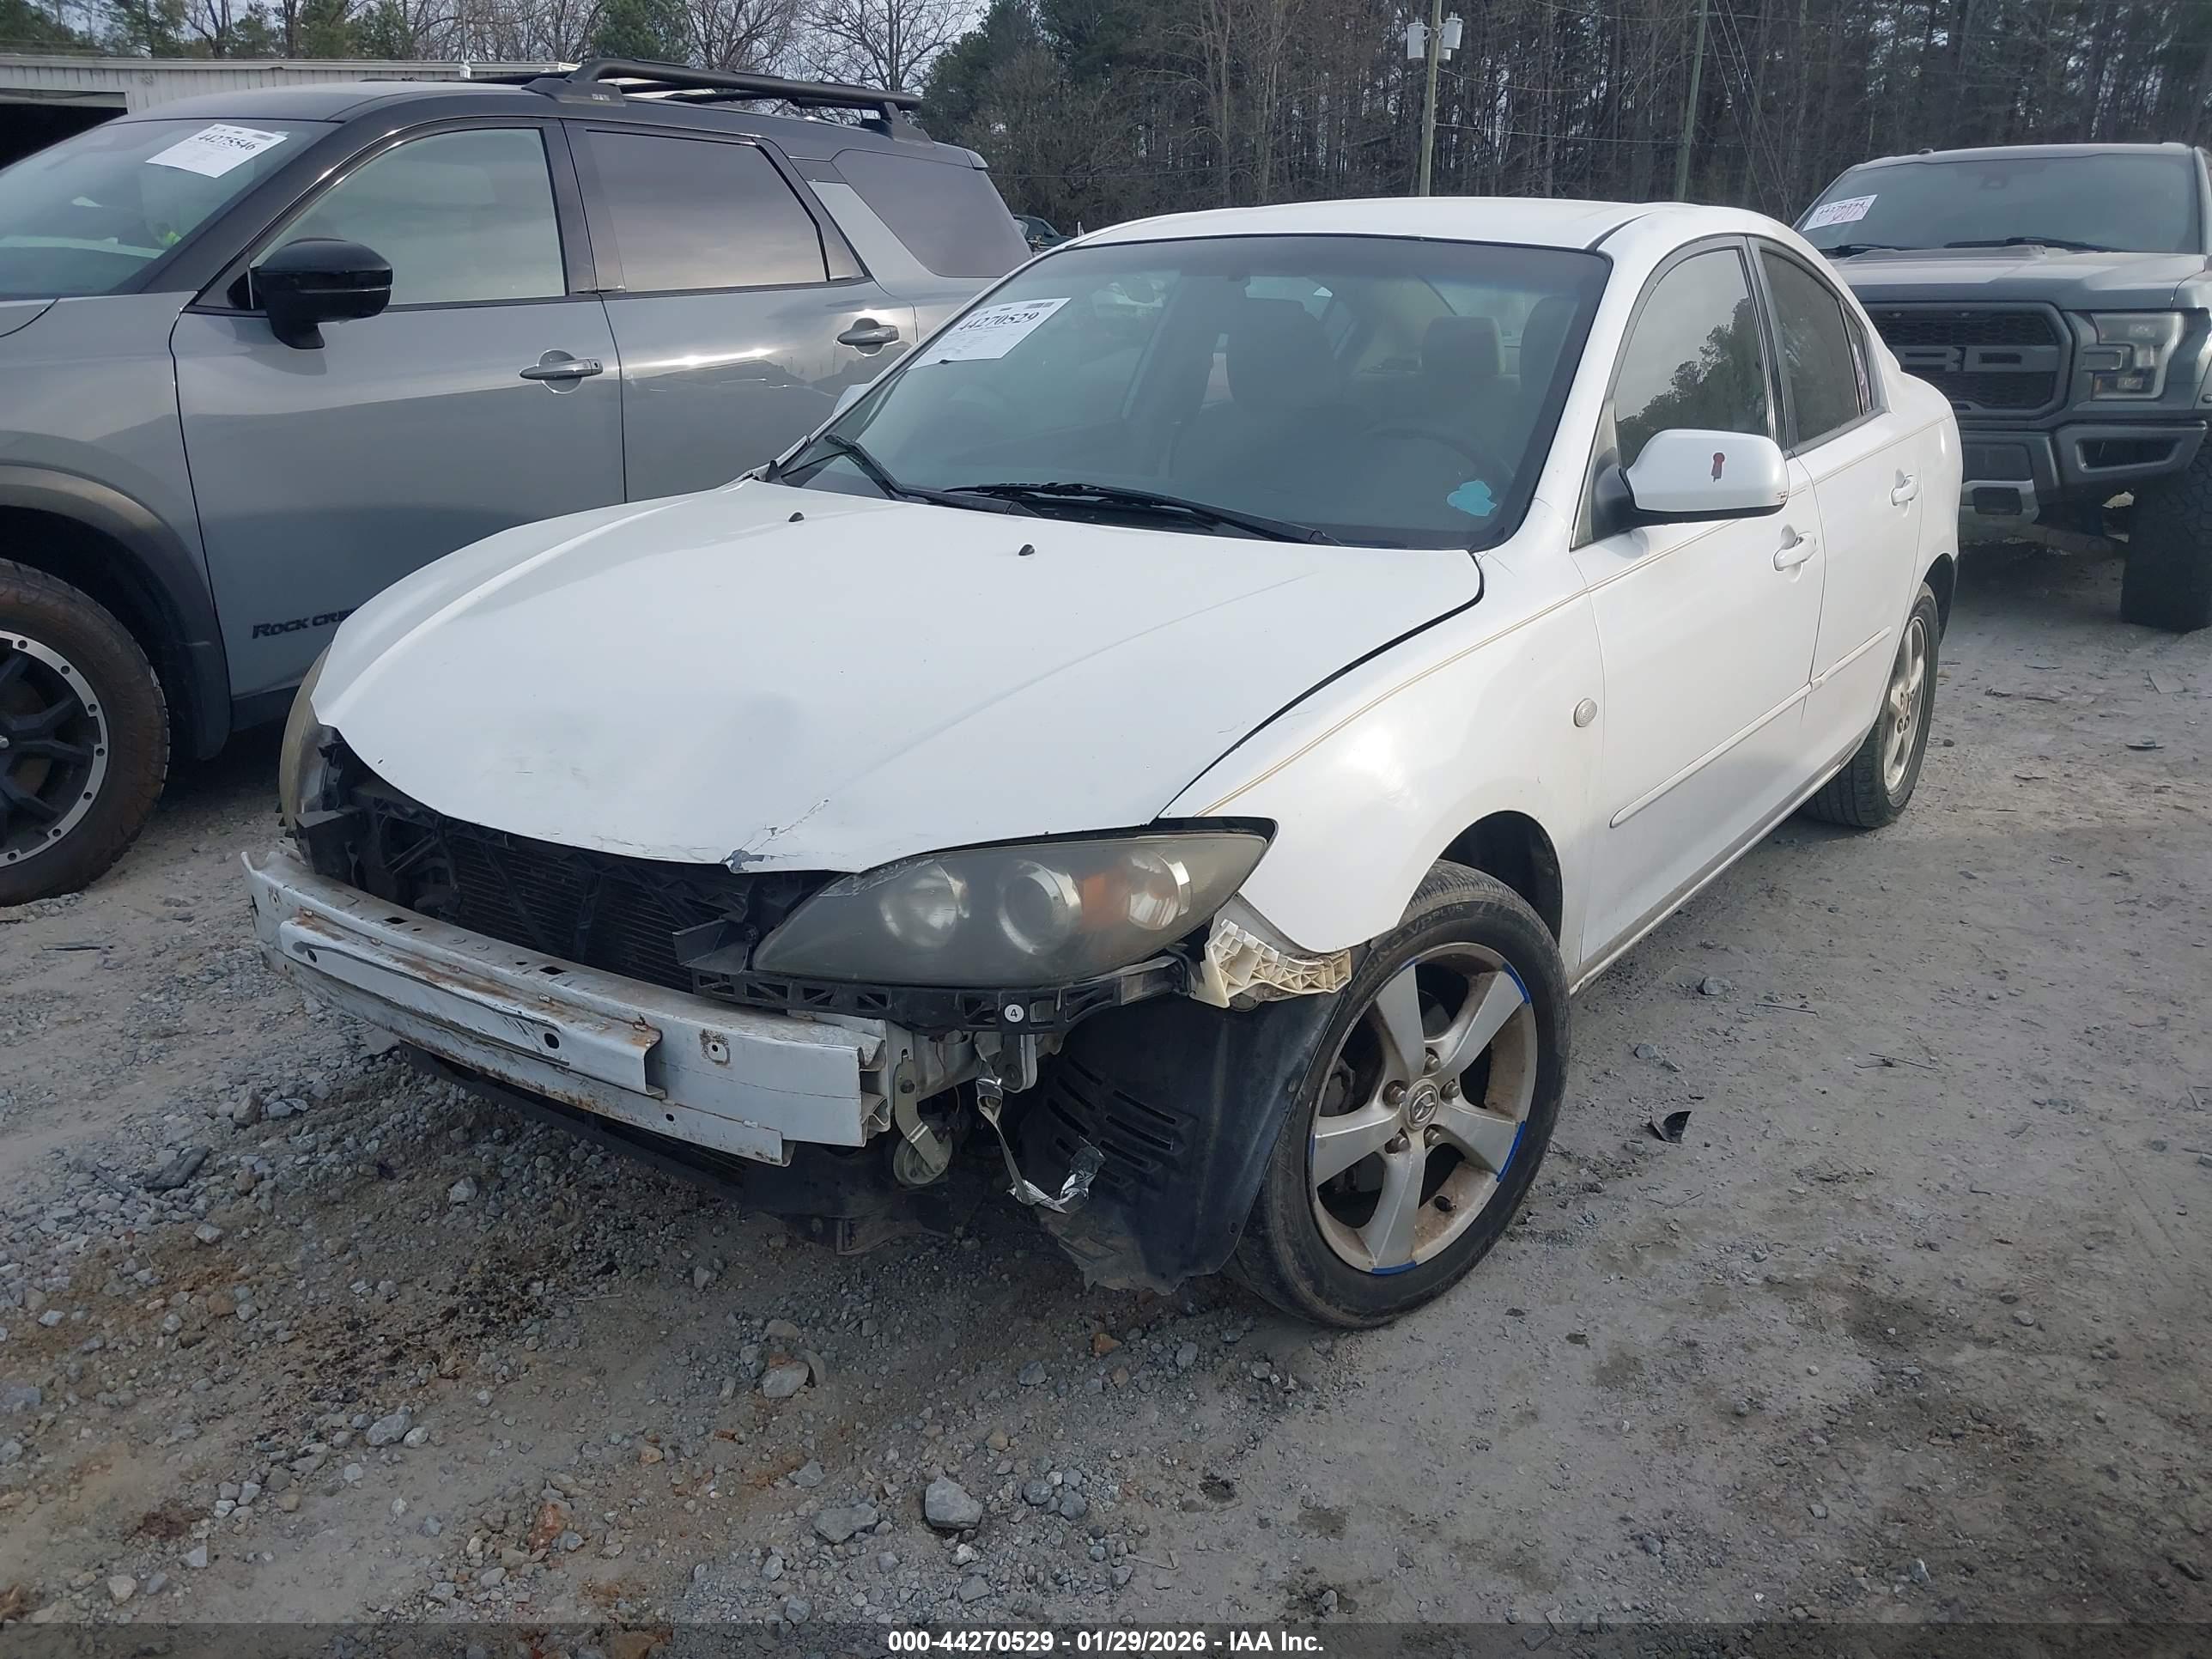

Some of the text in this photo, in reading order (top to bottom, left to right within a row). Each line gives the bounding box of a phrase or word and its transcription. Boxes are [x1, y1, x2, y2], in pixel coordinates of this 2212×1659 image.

[959, 312, 1040, 331] 44270529
[252, 606, 359, 640] ROCK CRE
